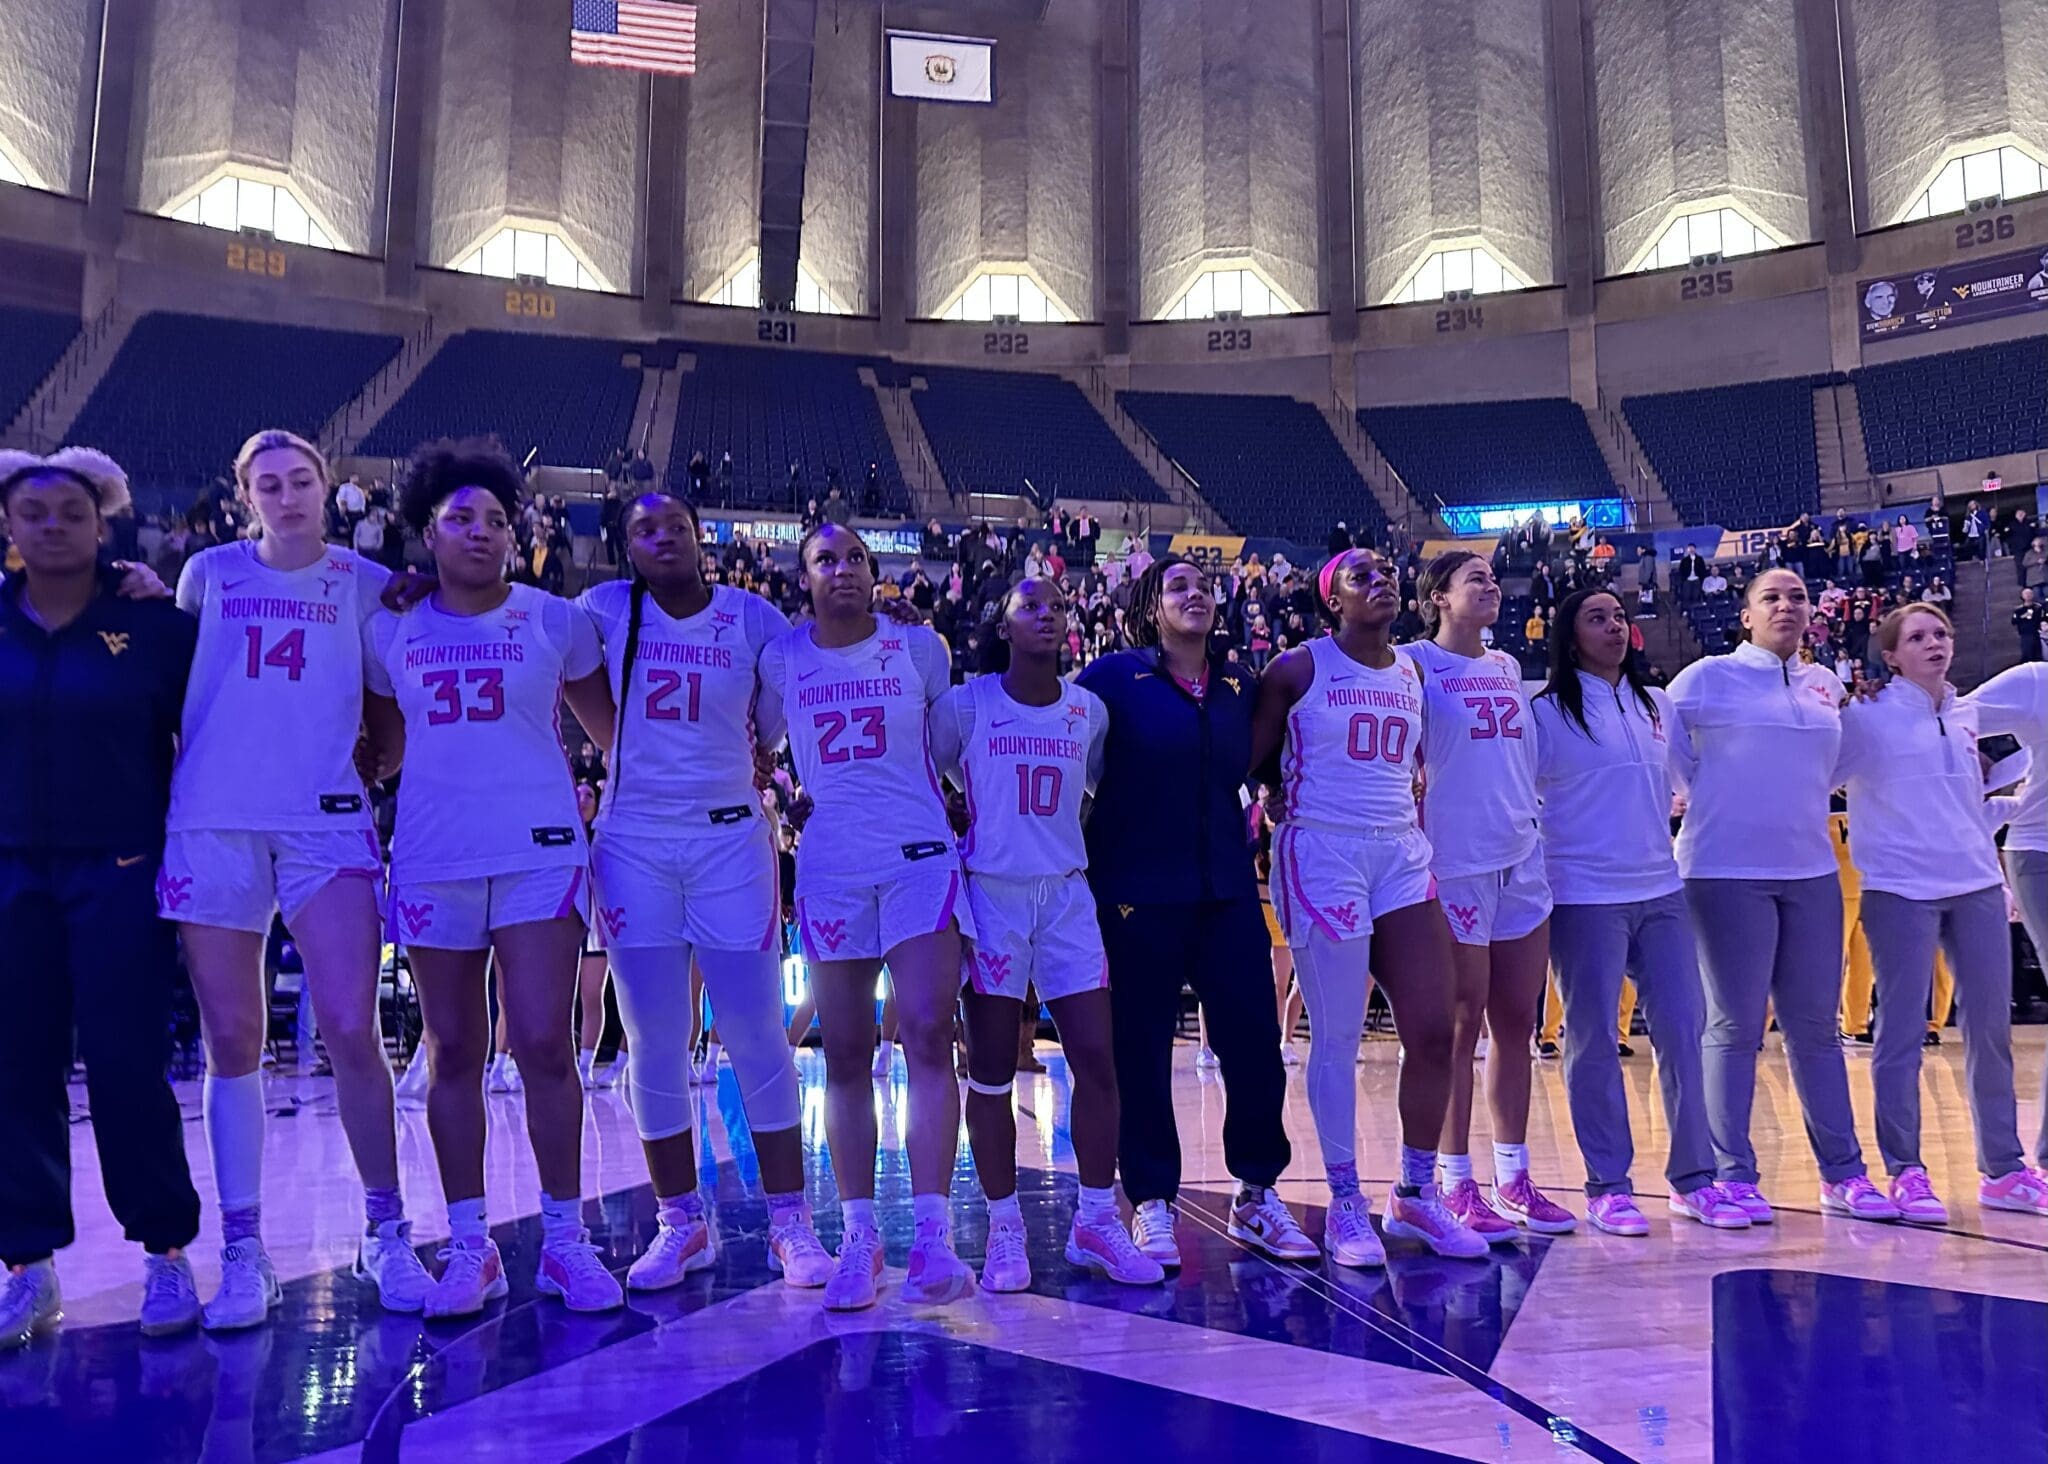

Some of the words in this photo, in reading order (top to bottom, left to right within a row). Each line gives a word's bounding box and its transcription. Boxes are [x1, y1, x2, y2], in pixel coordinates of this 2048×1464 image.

[1955, 216, 2015, 248] 236
[227, 244, 286, 278] 229
[1681, 270, 1733, 299] 235
[1971, 273, 2024, 293] MOUNTAINEER
[505, 291, 556, 320] 230
[1436, 307, 1483, 333] 234
[757, 319, 796, 344] 231
[984, 333, 1029, 354] 232
[1207, 329, 1252, 352] 233
[222, 598, 338, 625] MOUNTAINEERS
[245, 625, 306, 681] 14
[405, 642, 524, 670] MOUNTAINEERS
[635, 640, 732, 669] UNTAINEERS
[422, 668, 505, 726] 33
[646, 668, 702, 722] 21
[799, 678, 902, 709] MOUNTAINEERS
[1326, 689, 1420, 716] MOUNTAINEERS
[1464, 696, 1522, 740] 32
[814, 706, 887, 764] 23
[989, 736, 1082, 762] MOUNTAINEERS
[1347, 712, 1408, 763] 00
[1016, 764, 1063, 816] 10
